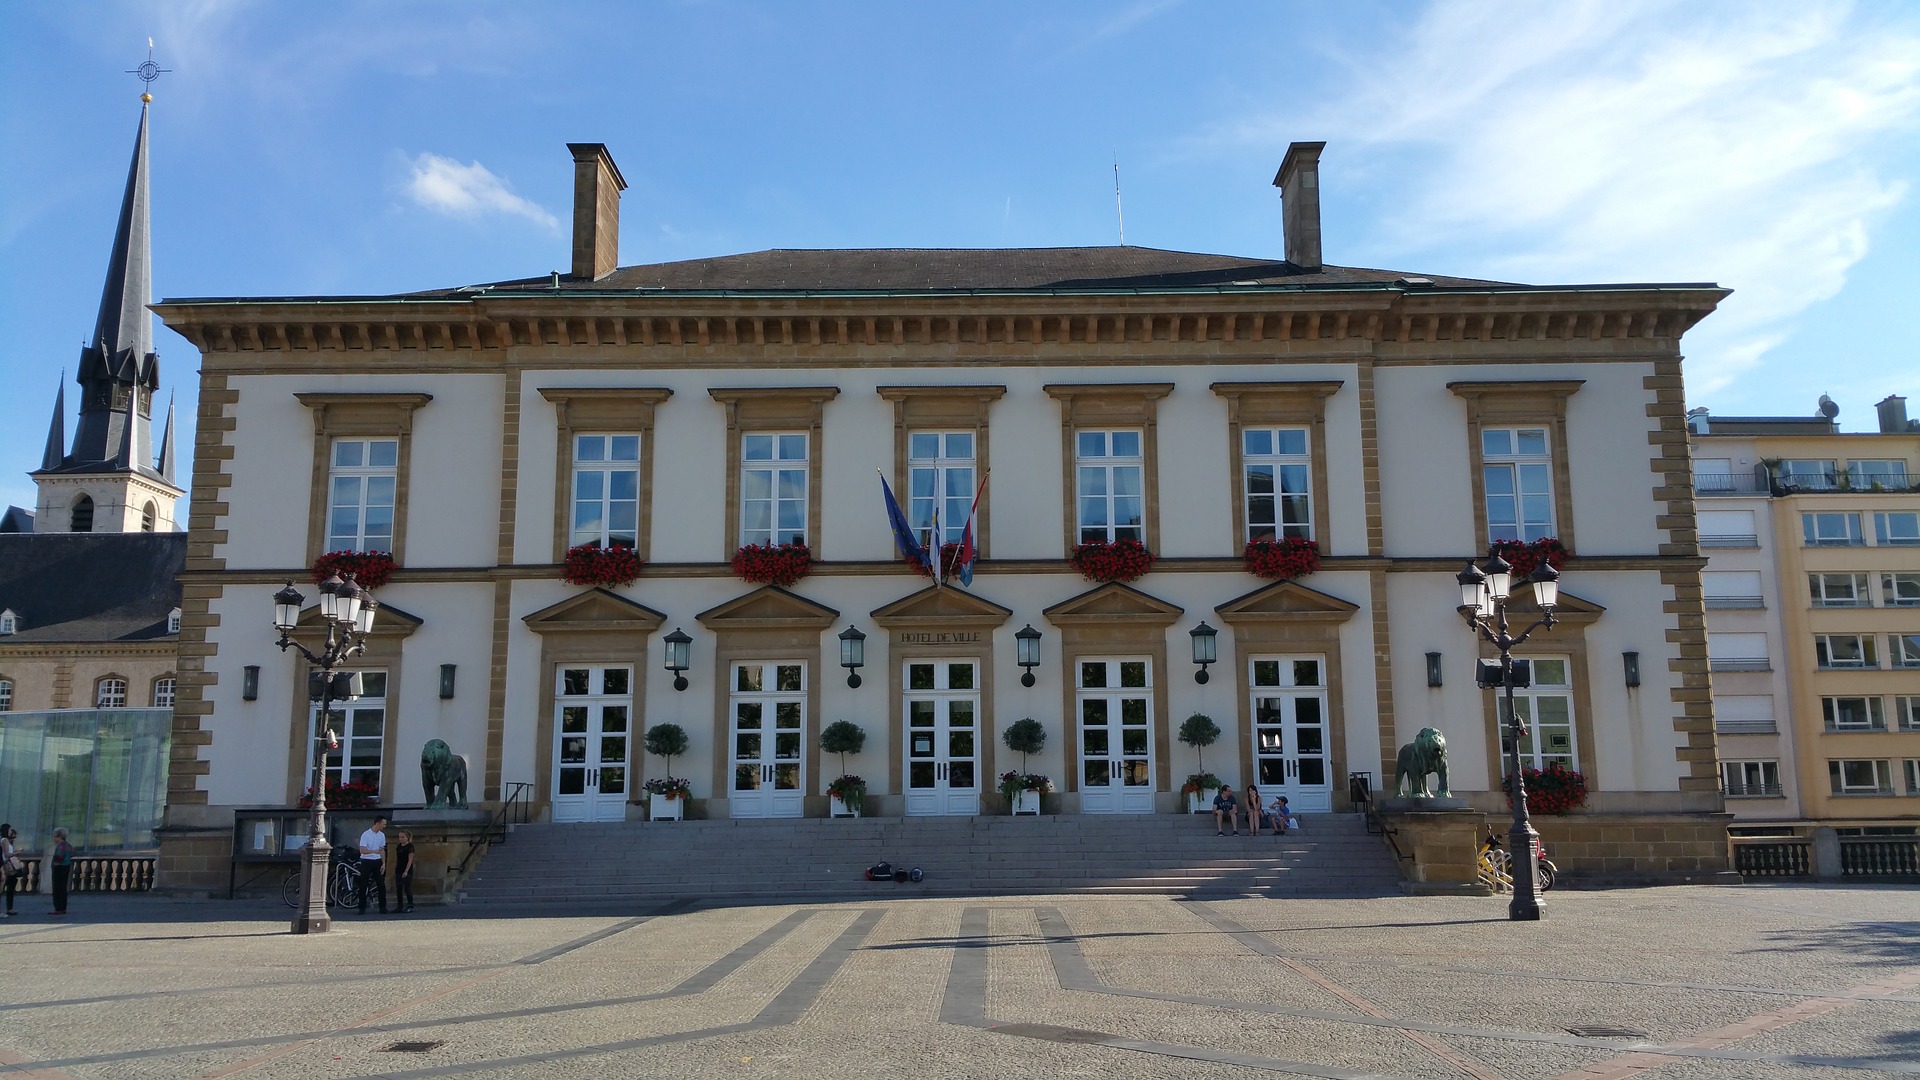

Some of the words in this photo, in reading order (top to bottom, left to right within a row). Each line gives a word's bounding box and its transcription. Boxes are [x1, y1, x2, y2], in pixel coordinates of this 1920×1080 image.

[901, 632, 935, 643] HOTEL
[936, 632, 951, 642] DE
[952, 632, 981, 642] VILLE
